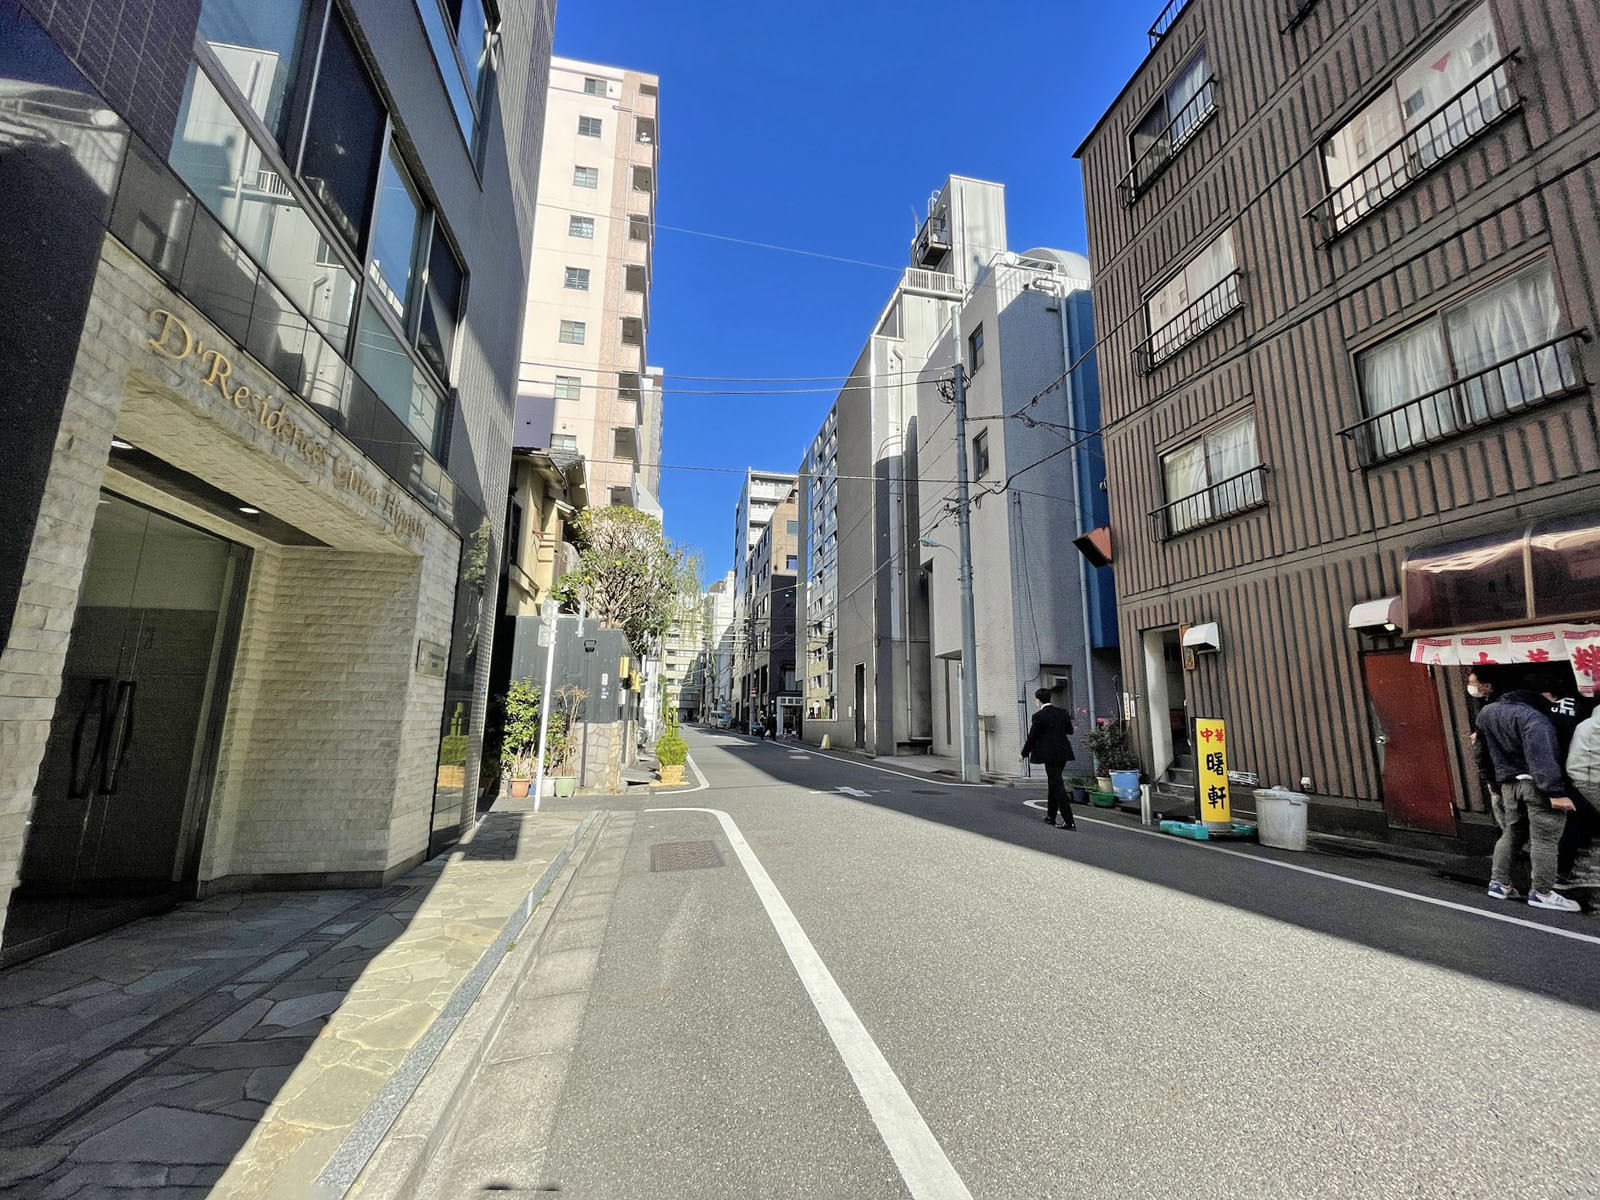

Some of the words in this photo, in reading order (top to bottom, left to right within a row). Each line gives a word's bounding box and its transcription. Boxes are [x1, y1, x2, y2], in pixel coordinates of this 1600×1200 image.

[334, 454, 380, 507] Ginza
[382, 493, 427, 541] Higashi
[1200, 728, 1224, 743] 中華
[1206, 752, 1227, 809] 曙軒
